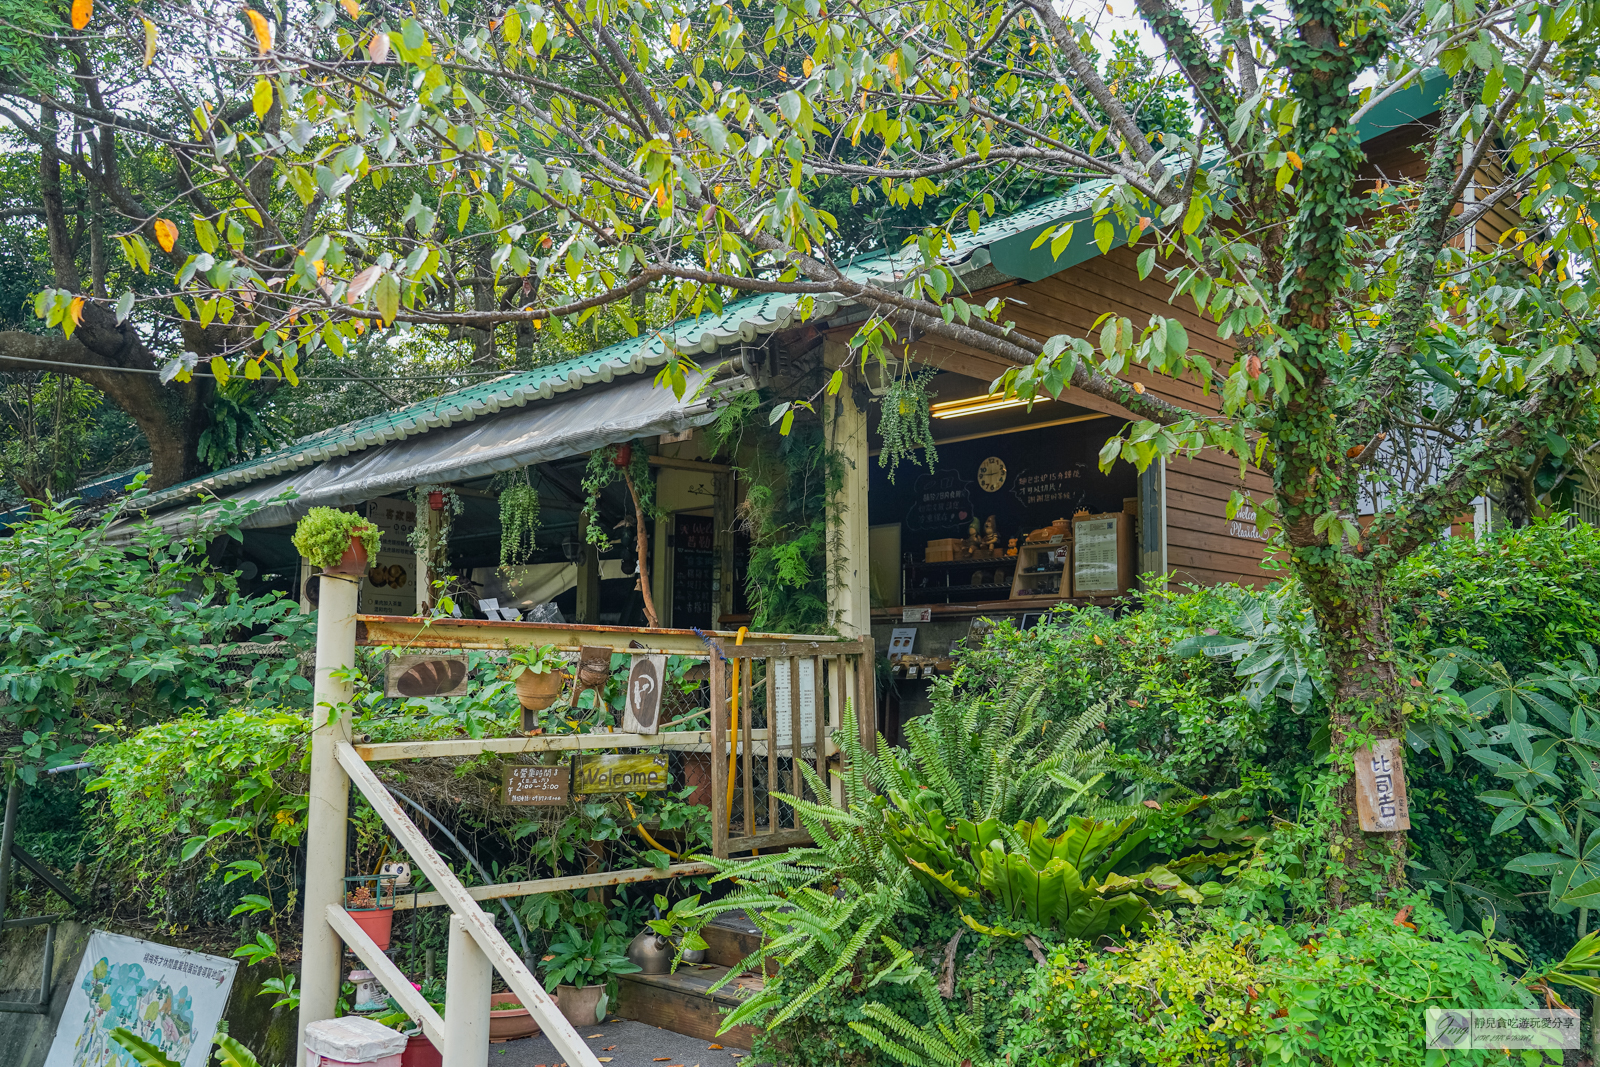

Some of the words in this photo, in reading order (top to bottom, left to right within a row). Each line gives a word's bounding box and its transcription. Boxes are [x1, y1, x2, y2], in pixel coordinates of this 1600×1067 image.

[584, 768, 659, 786] Welcome
[1371, 755, 1396, 818] 比司吉
